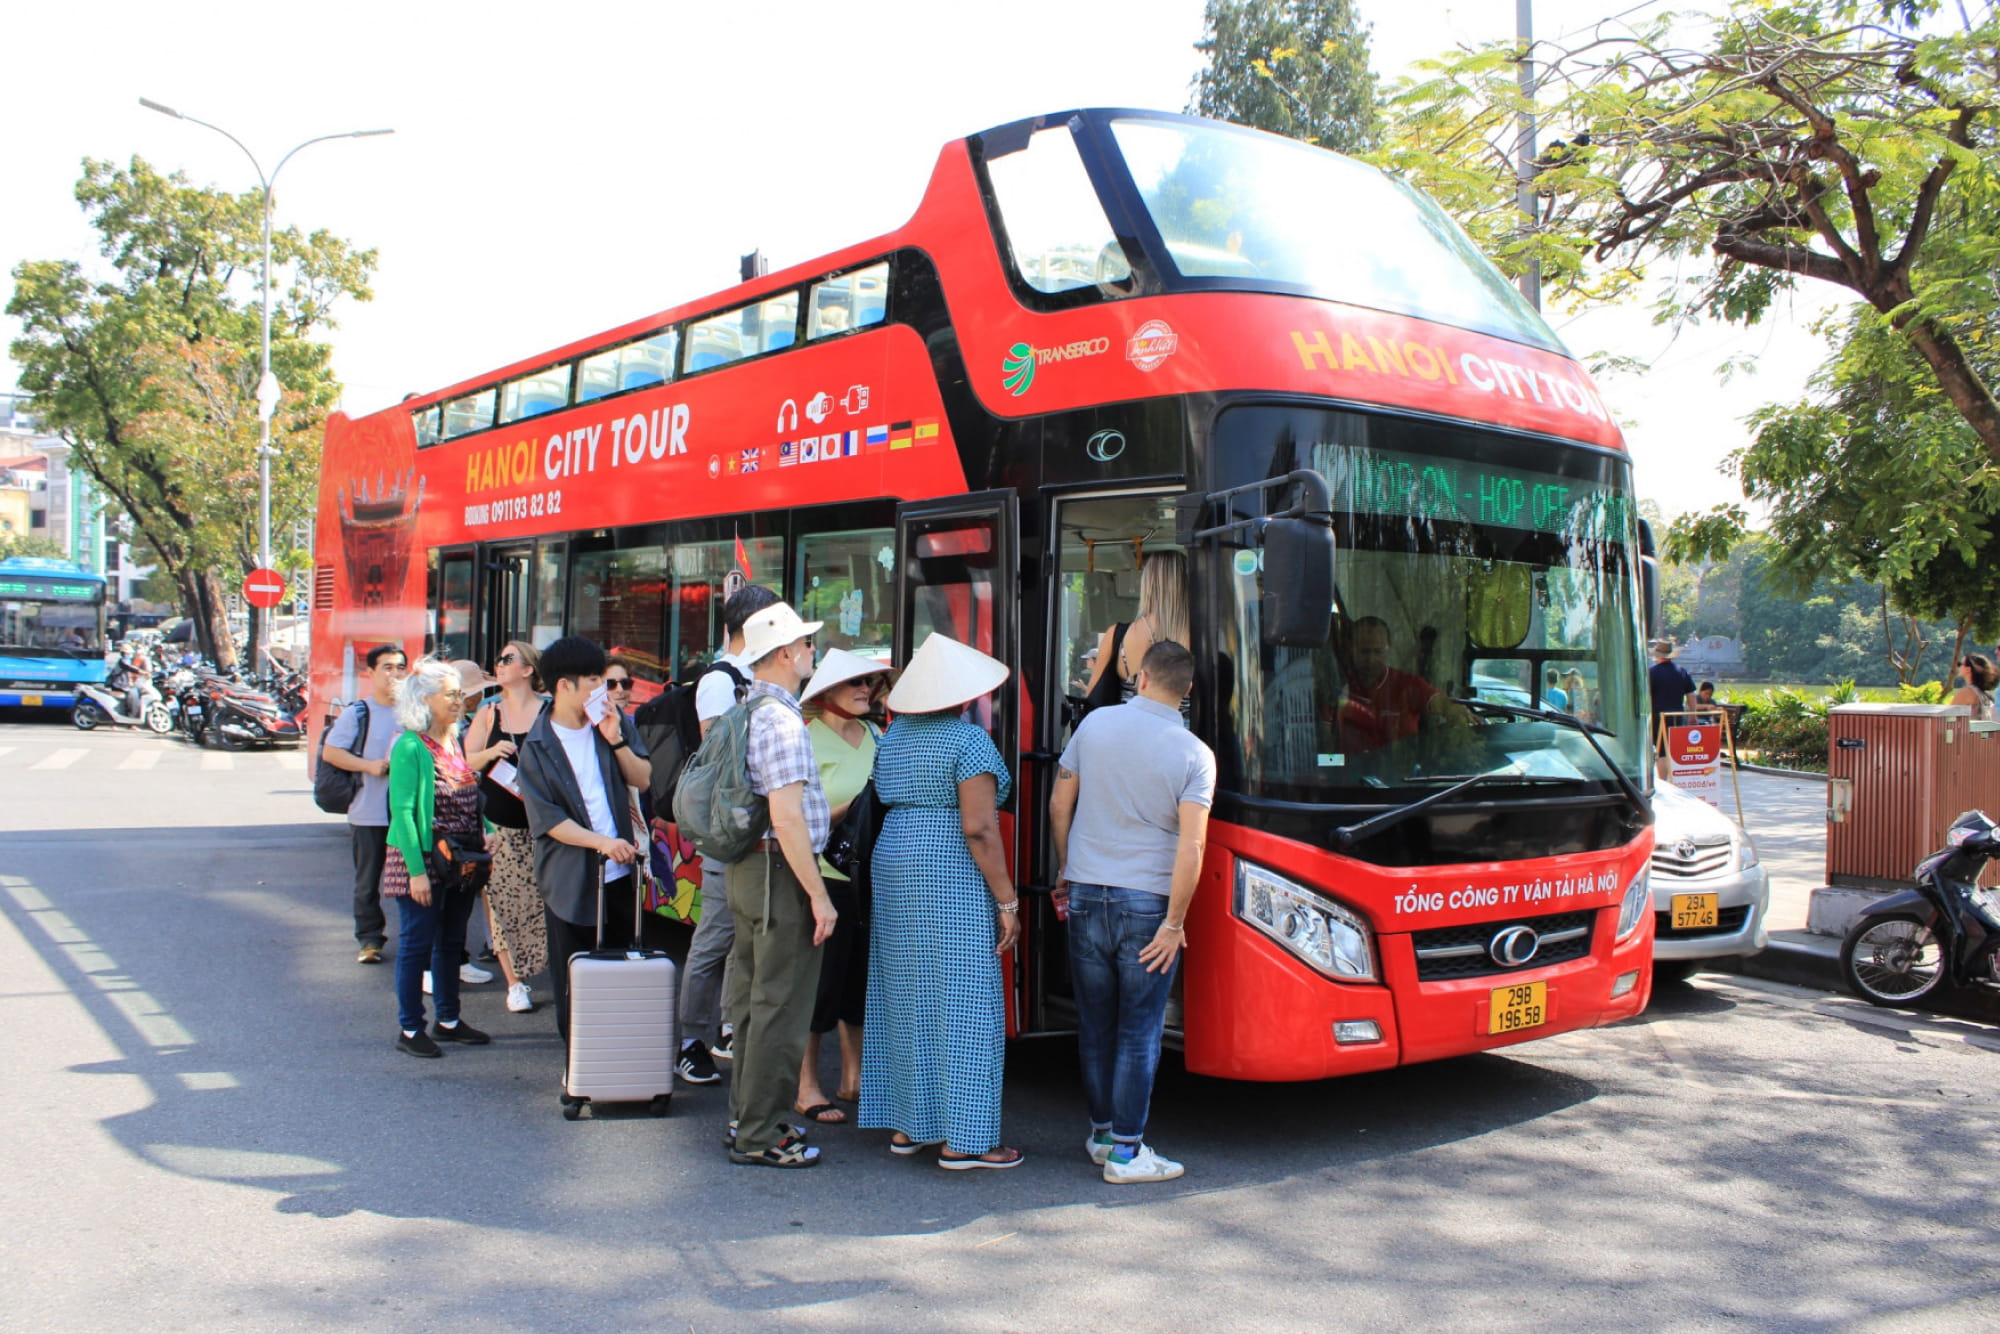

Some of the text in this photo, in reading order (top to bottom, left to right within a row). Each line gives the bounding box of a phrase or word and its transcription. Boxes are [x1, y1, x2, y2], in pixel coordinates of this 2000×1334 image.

[1036, 336, 1110, 366] TRANSERCO
[1290, 331, 1458, 385] HANOI
[1460, 352, 1544, 403] CITY
[465, 402, 690, 494] HANOI CITY TOUR
[530, 492, 544, 517] 82
[546, 489, 561, 515] 82
[1355, 457, 1413, 511] HOP
[1421, 465, 1457, 516] ON
[1479, 473, 1526, 526] HOP
[1532, 482, 1569, 531] OFF
[1395, 869, 1619, 914] TỔNG CÔNG TY VẬN TẢI HÀ NỘI
[1686, 895, 1705, 911] 29A
[1678, 910, 1713, 927] 577.46
[1507, 985, 1532, 1008] 29B
[1498, 1005, 1541, 1031] 196.58
